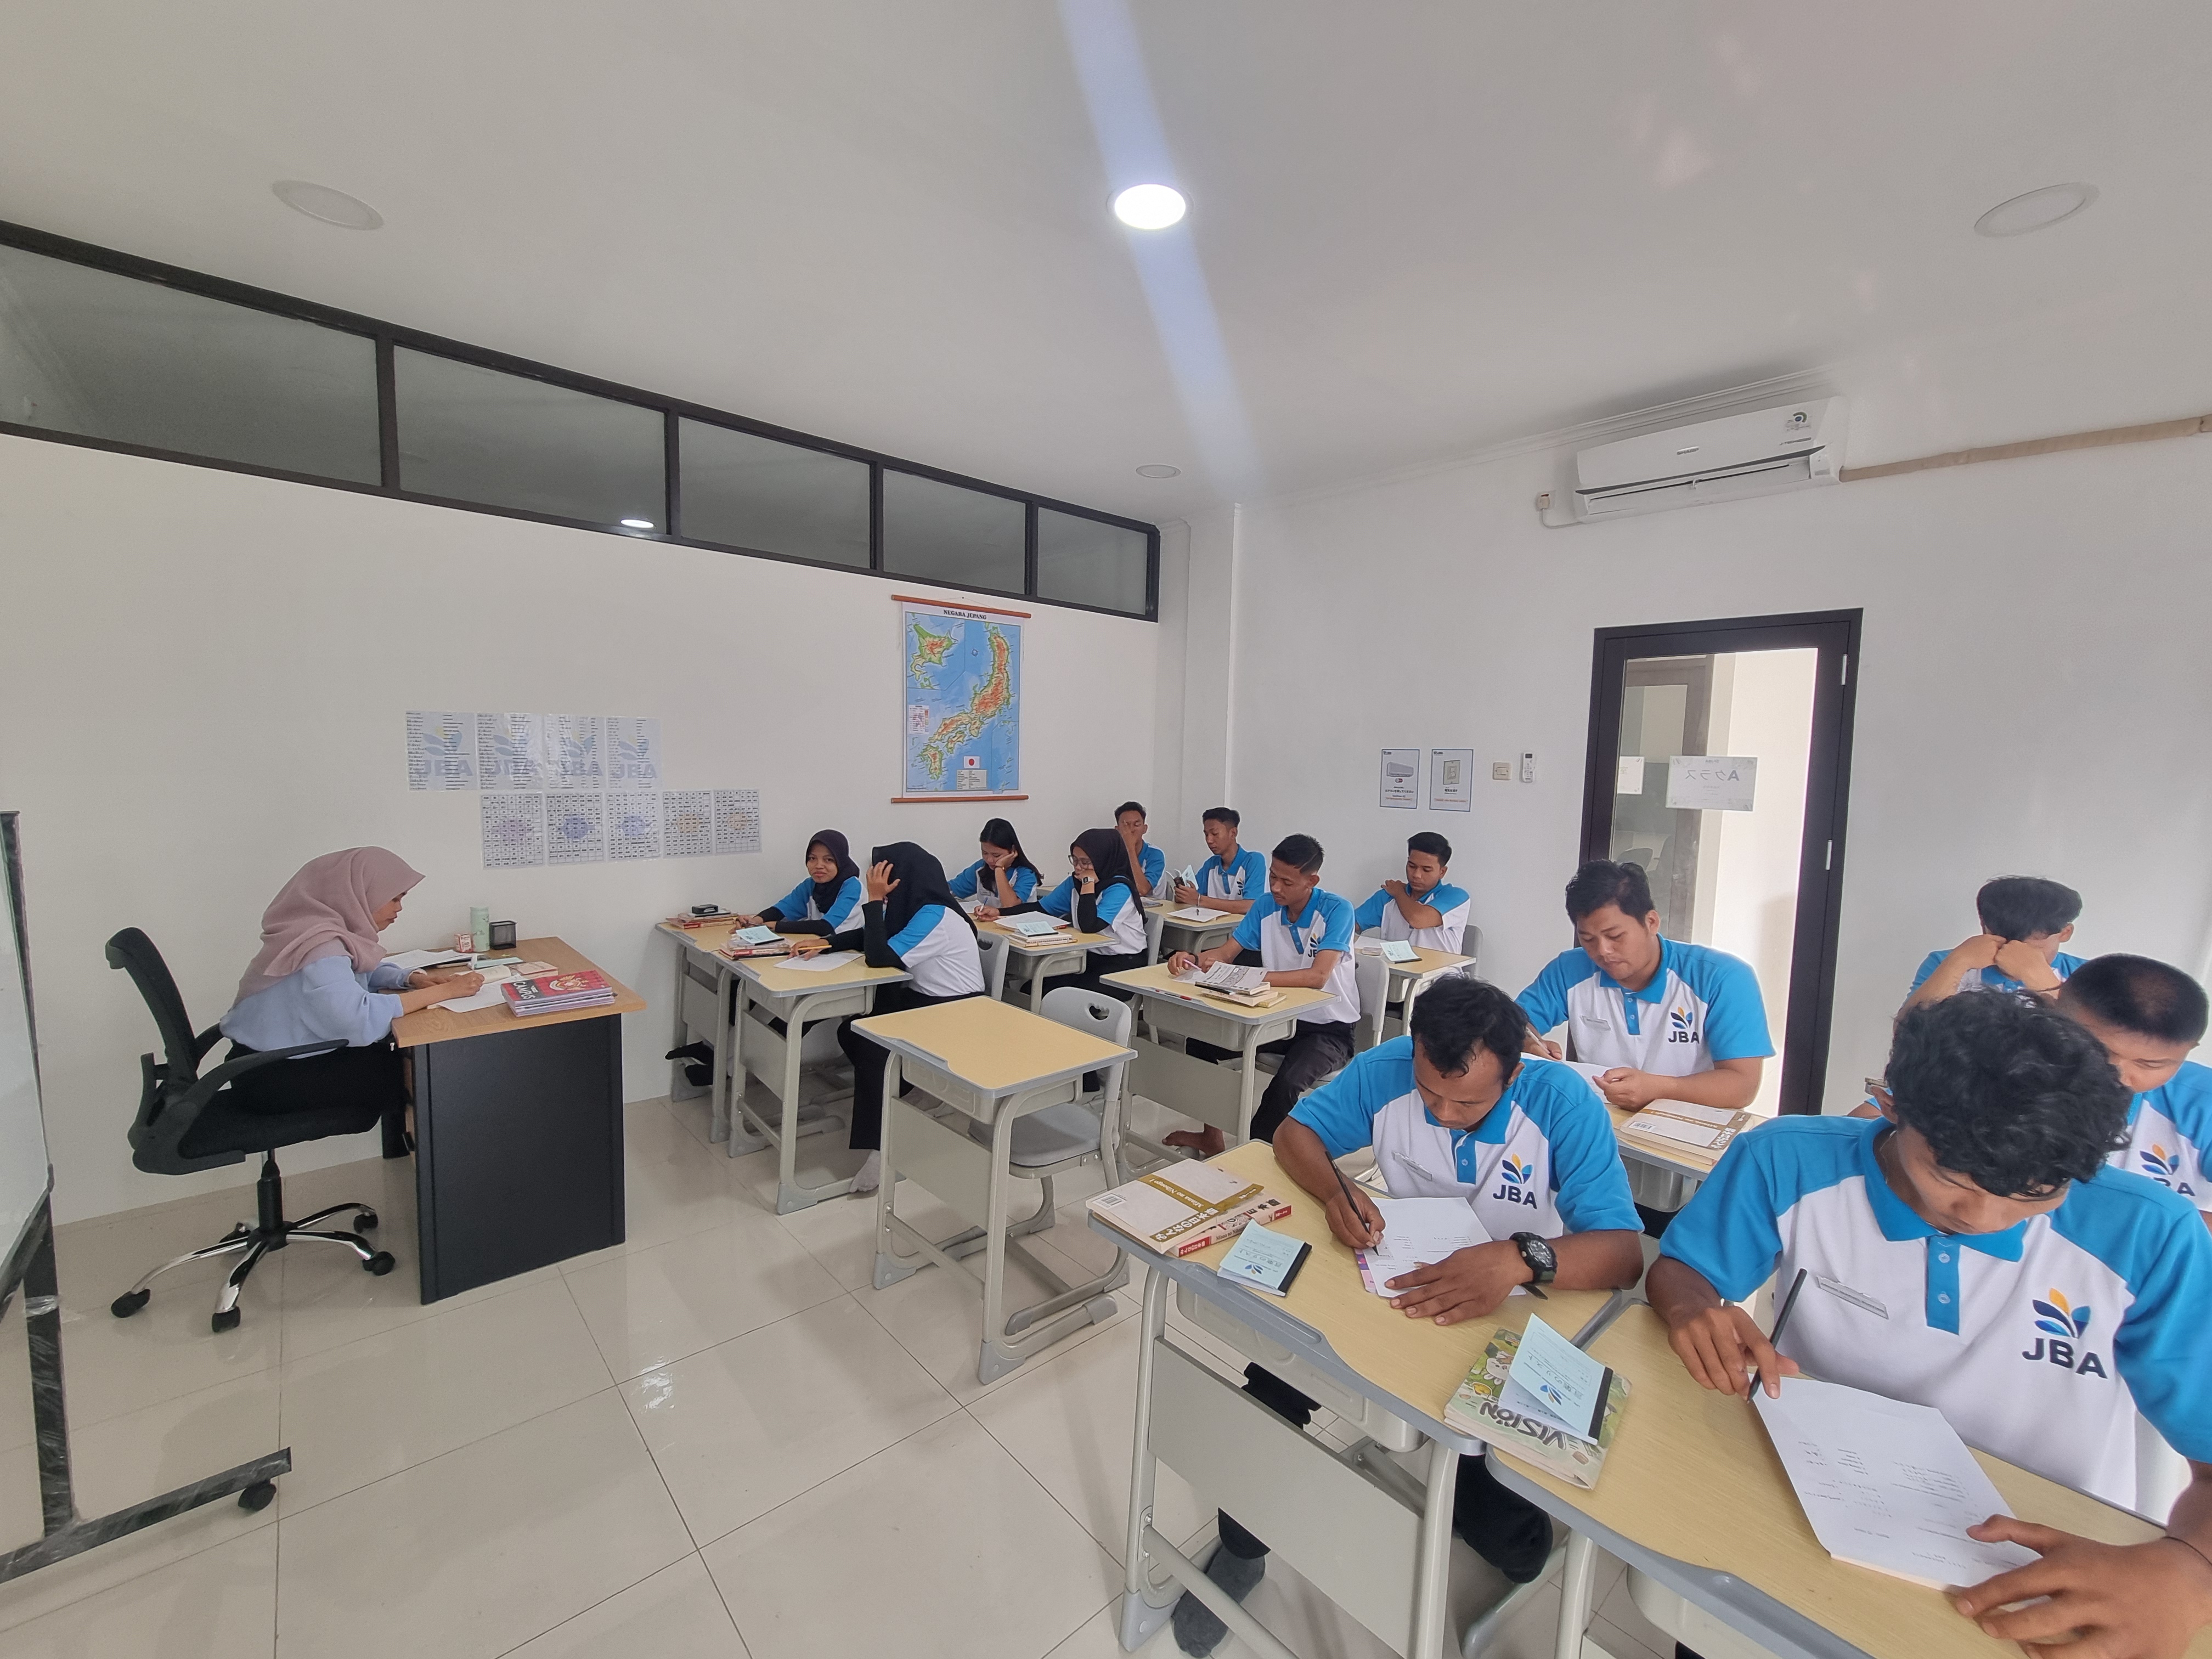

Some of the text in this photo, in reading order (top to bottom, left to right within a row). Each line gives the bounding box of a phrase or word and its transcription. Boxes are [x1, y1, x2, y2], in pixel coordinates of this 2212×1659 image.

[943, 609, 966, 617] NEGARA
[513, 981, 536, 1000] CAMPUS
[1668, 1030, 1700, 1044] JBA
[1154, 1180, 1177, 1194] Nihongo
[1184, 1196, 1204, 1208] Minna
[1492, 1184, 1538, 1210] JBA
[1155, 1207, 1219, 1241] みんなの日本語
[2021, 1337, 2108, 1379] JBA
